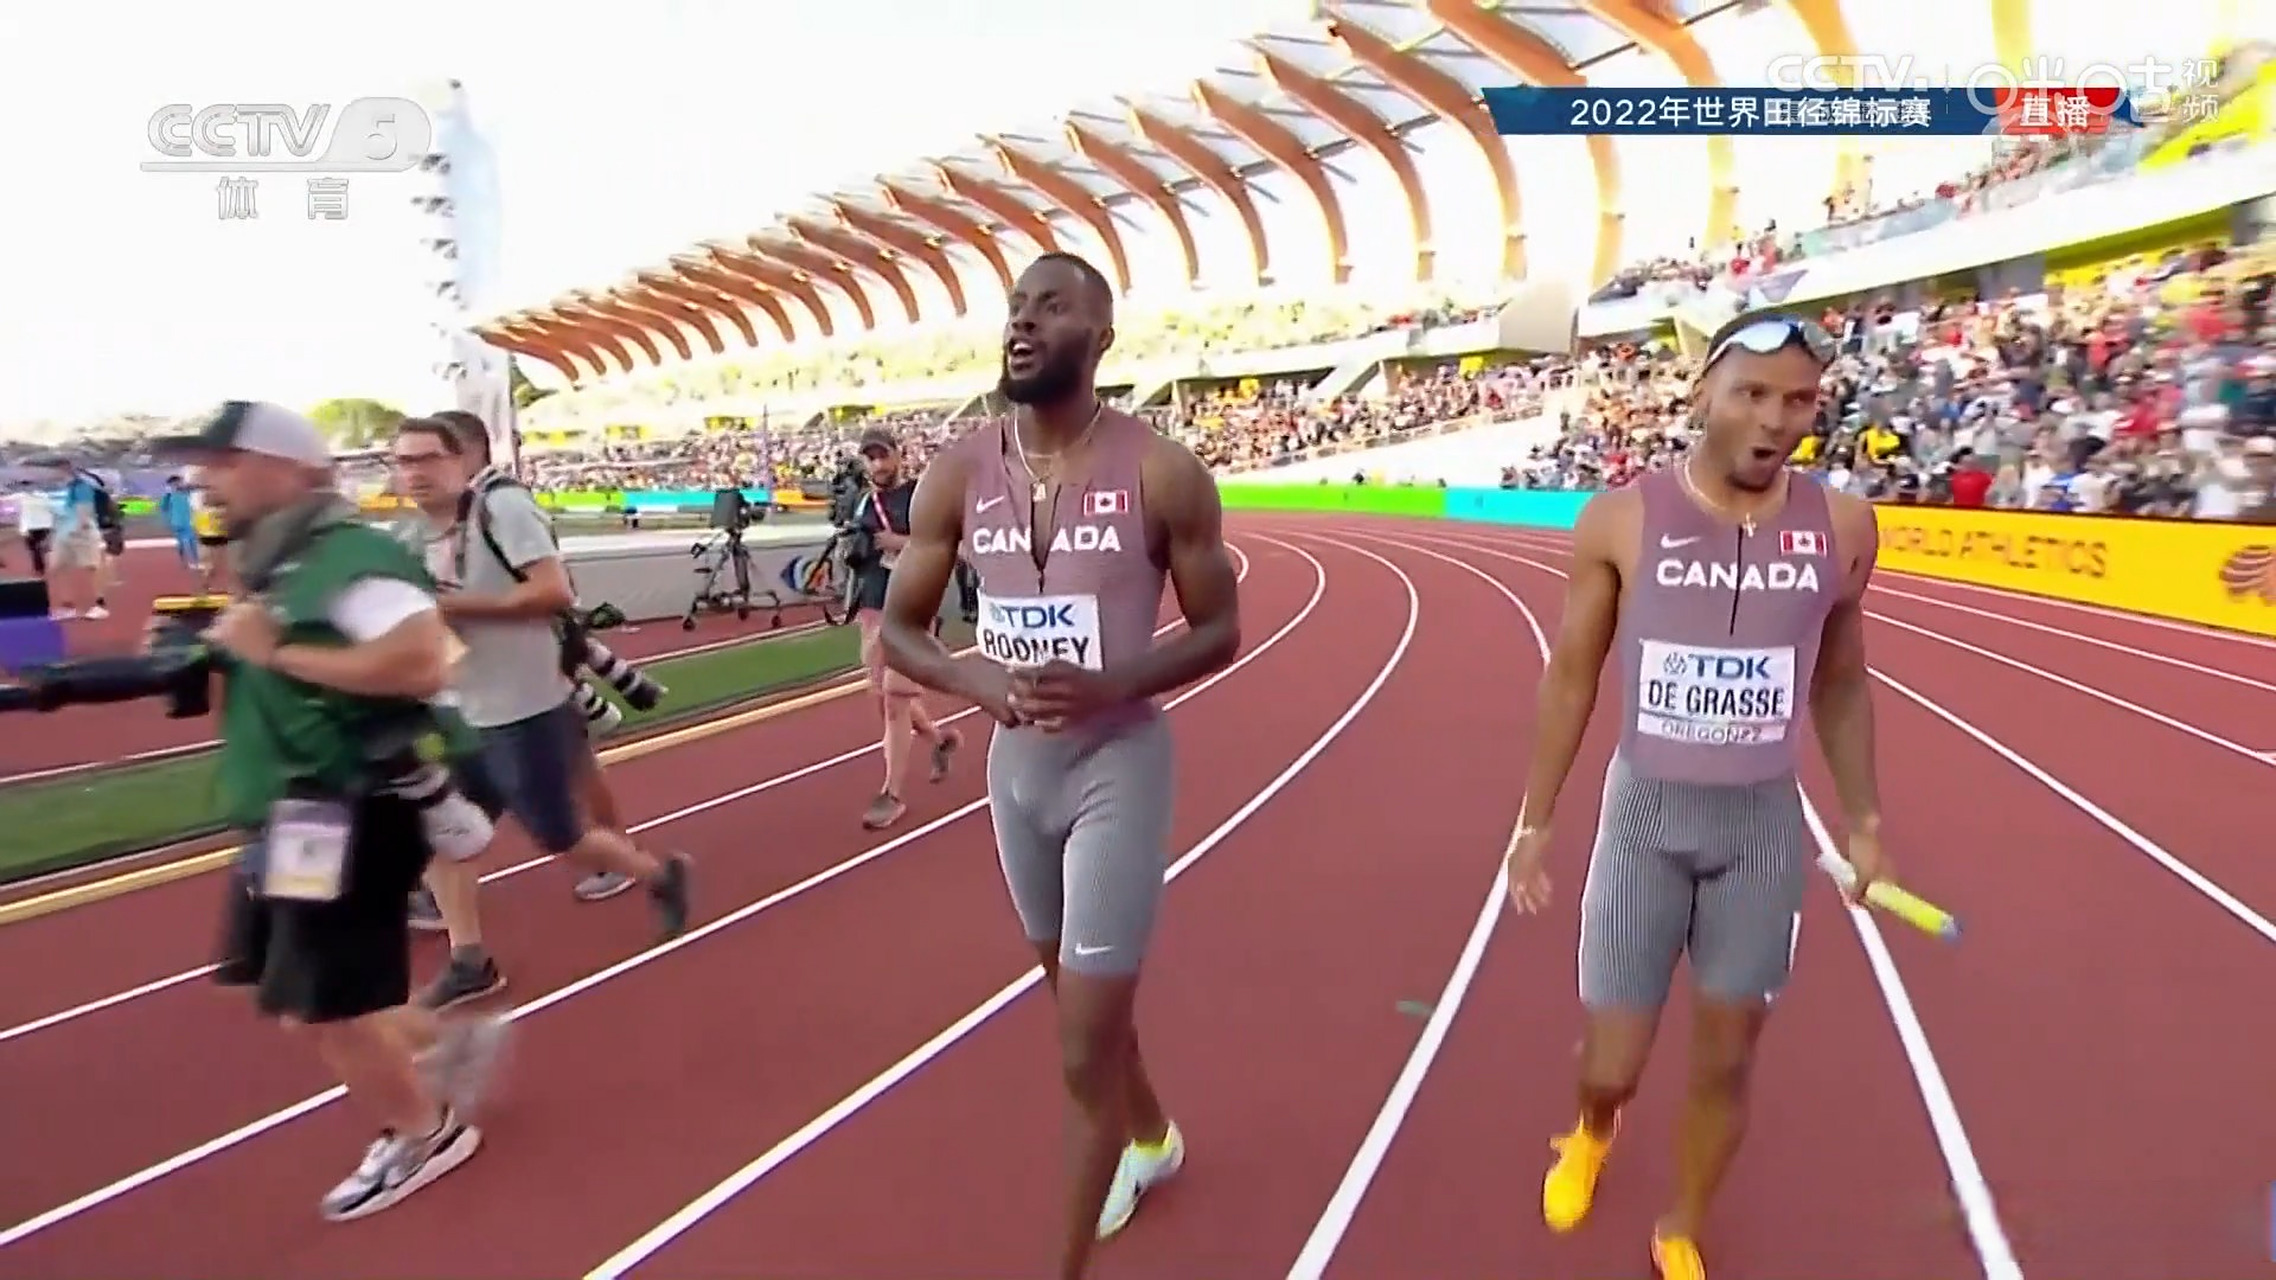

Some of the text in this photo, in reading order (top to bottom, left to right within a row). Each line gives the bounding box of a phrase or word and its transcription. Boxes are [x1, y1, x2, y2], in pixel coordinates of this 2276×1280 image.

[972, 525, 1122, 553] CANADA
[1960, 530, 2107, 578] ATHLETICS
[1656, 558, 1819, 593] CANADA
[1000, 603, 1075, 628] TDK
[1688, 653, 1771, 680] TDK
[1648, 679, 1785, 717] DE GRASSE
